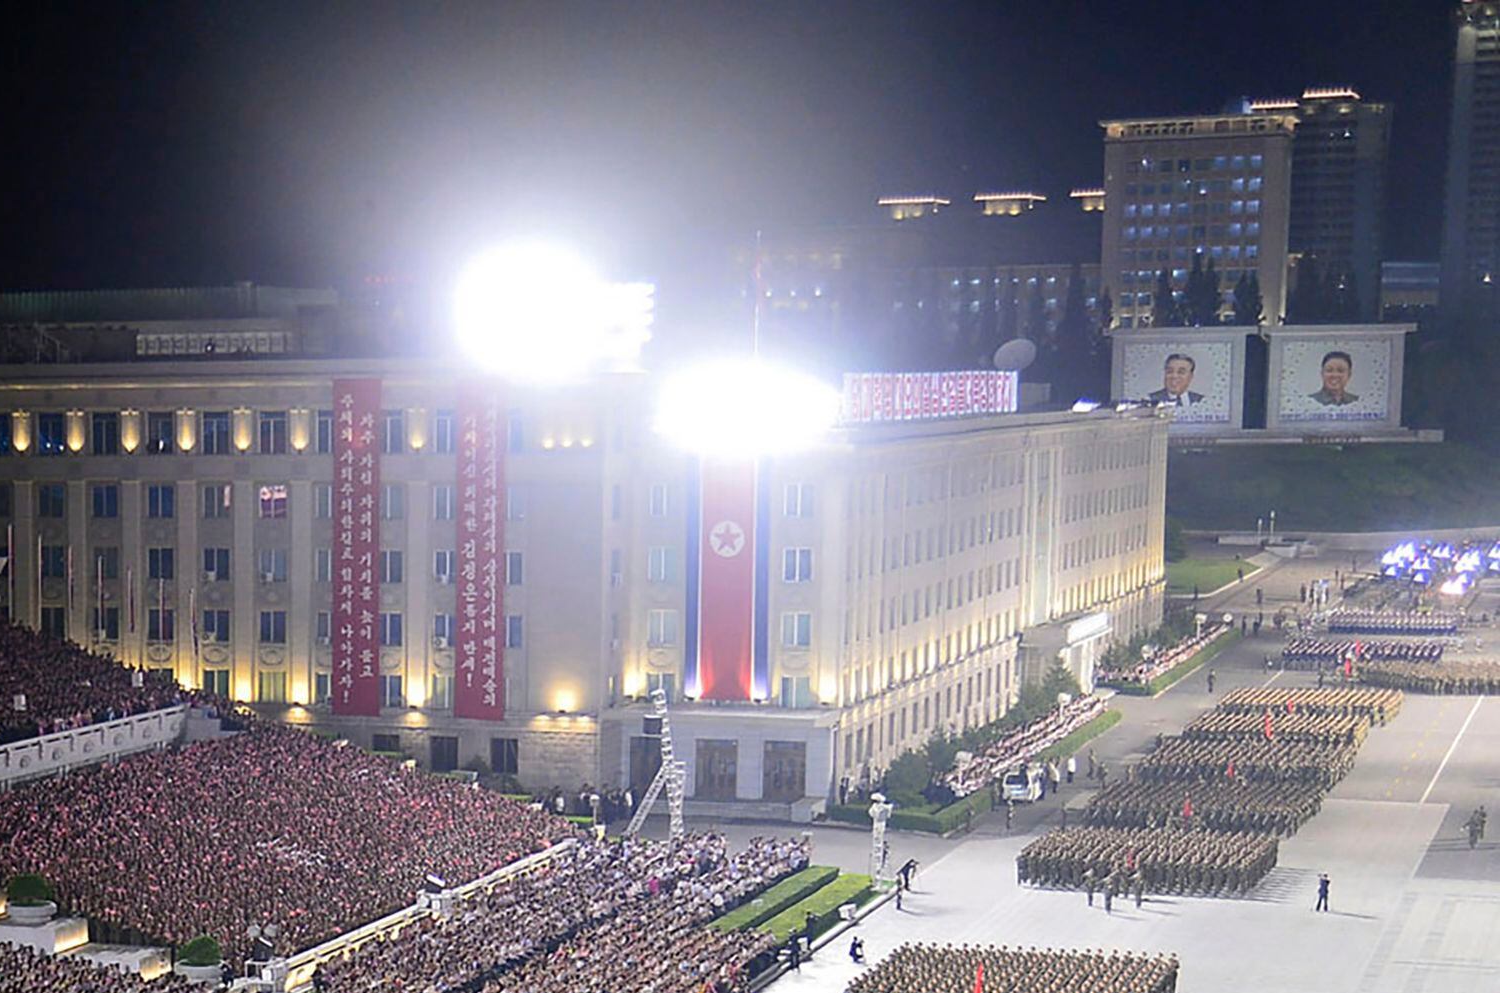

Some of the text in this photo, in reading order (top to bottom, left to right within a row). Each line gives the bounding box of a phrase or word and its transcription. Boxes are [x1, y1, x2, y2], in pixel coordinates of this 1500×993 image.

[339, 393, 354, 442] 주체의
[360, 412, 375, 444] 자주
[359, 552, 374, 601] 기치를
[461, 538, 478, 634] 김정은동지
[359, 609, 374, 640] 높이
[338, 624, 354, 704] 나아가자!
[359, 649, 375, 678] 들고
[460, 640, 477, 688] 만세!
